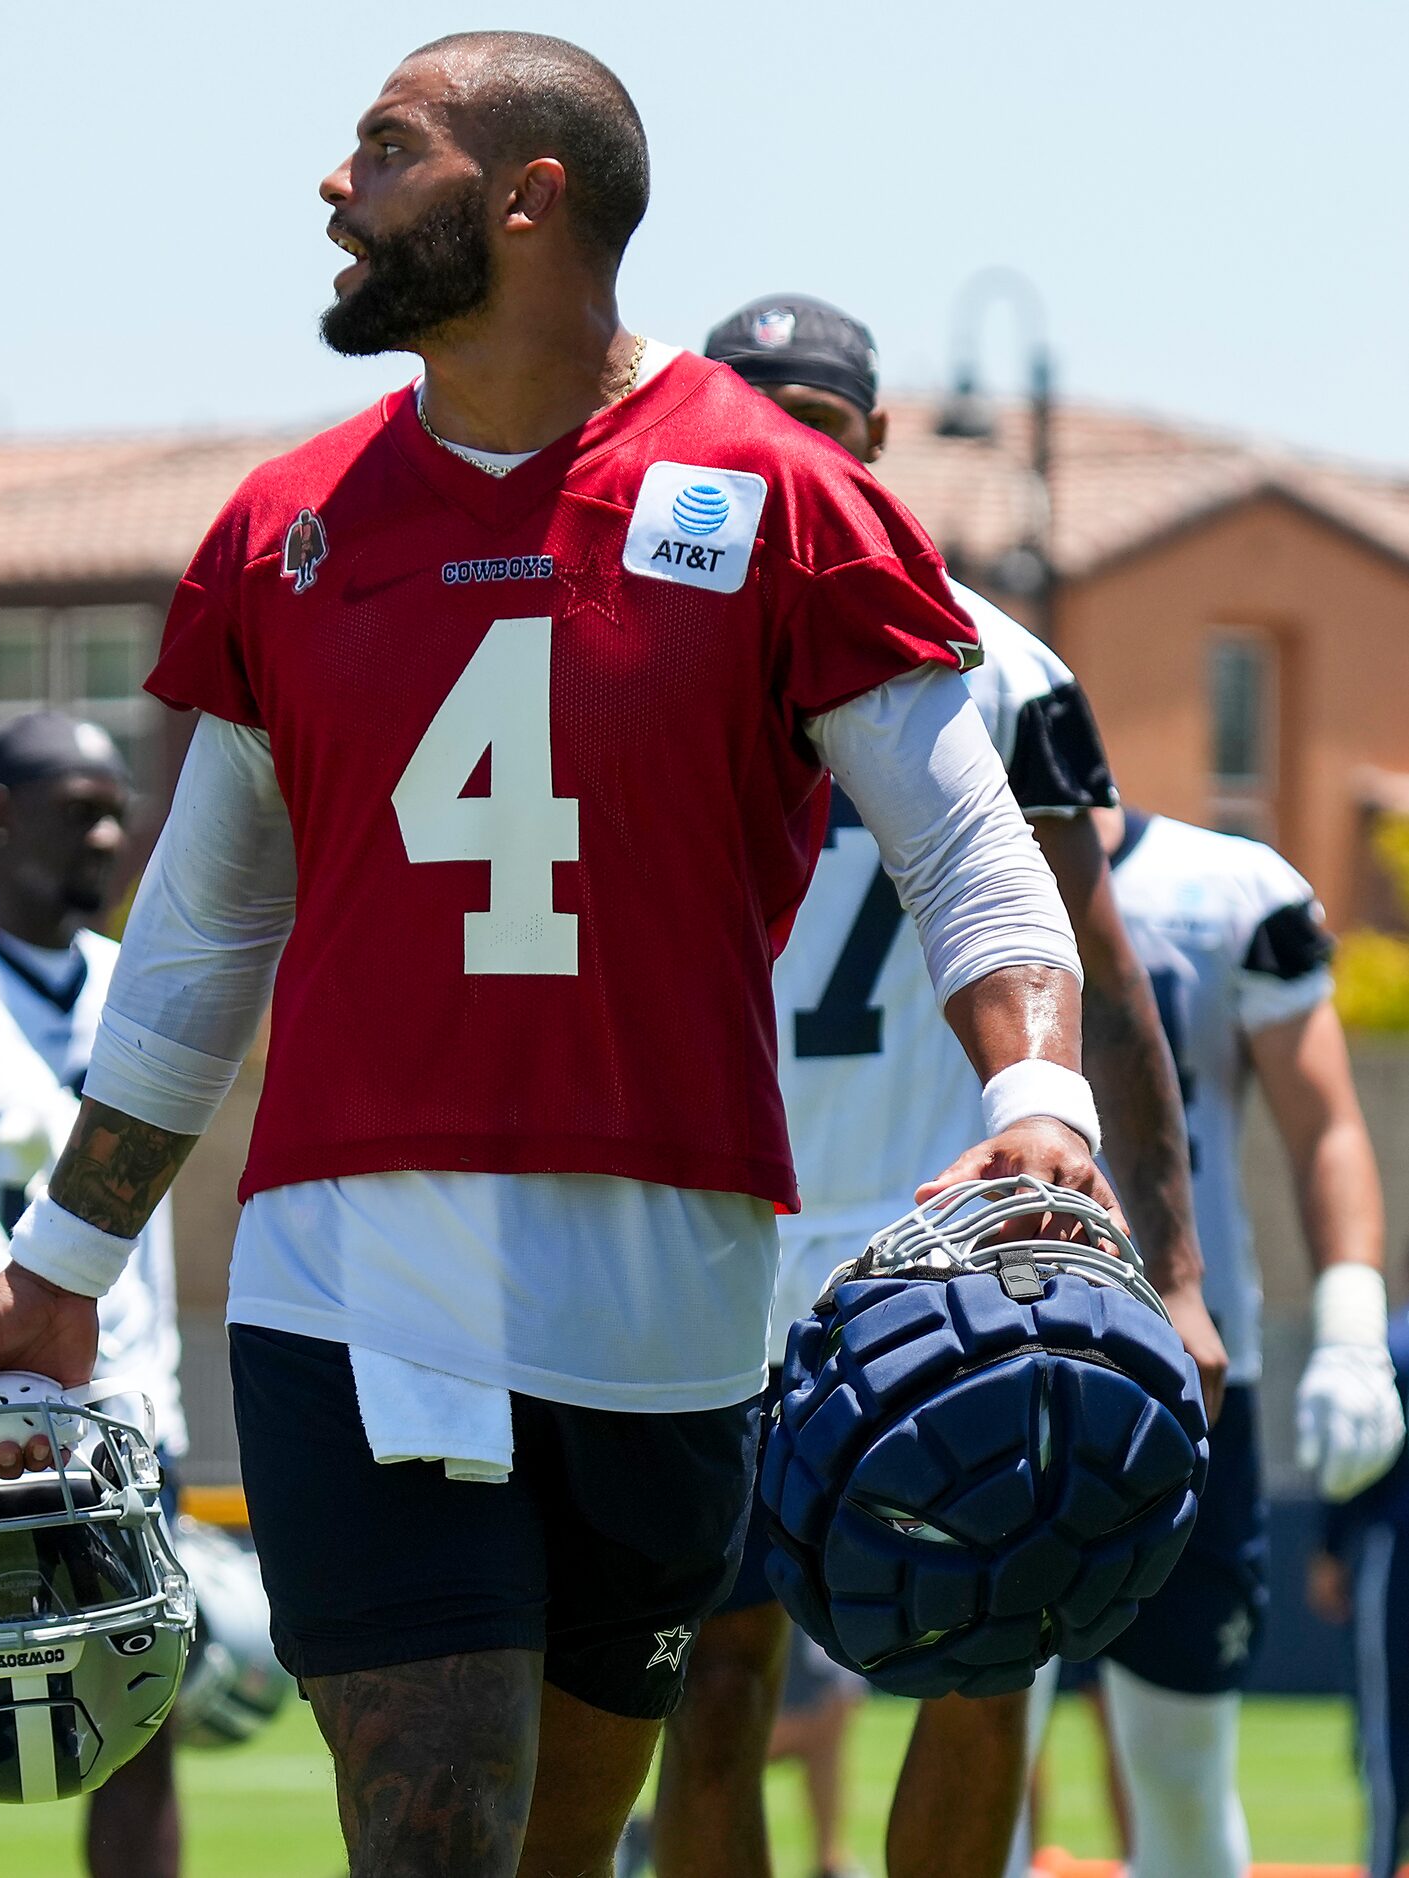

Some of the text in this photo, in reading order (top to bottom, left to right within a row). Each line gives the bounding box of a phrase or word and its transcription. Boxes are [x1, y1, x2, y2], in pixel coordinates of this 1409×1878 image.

[442, 555, 553, 584] COWBOYS
[651, 539, 726, 573] AT&T
[391, 616, 579, 976] 4
